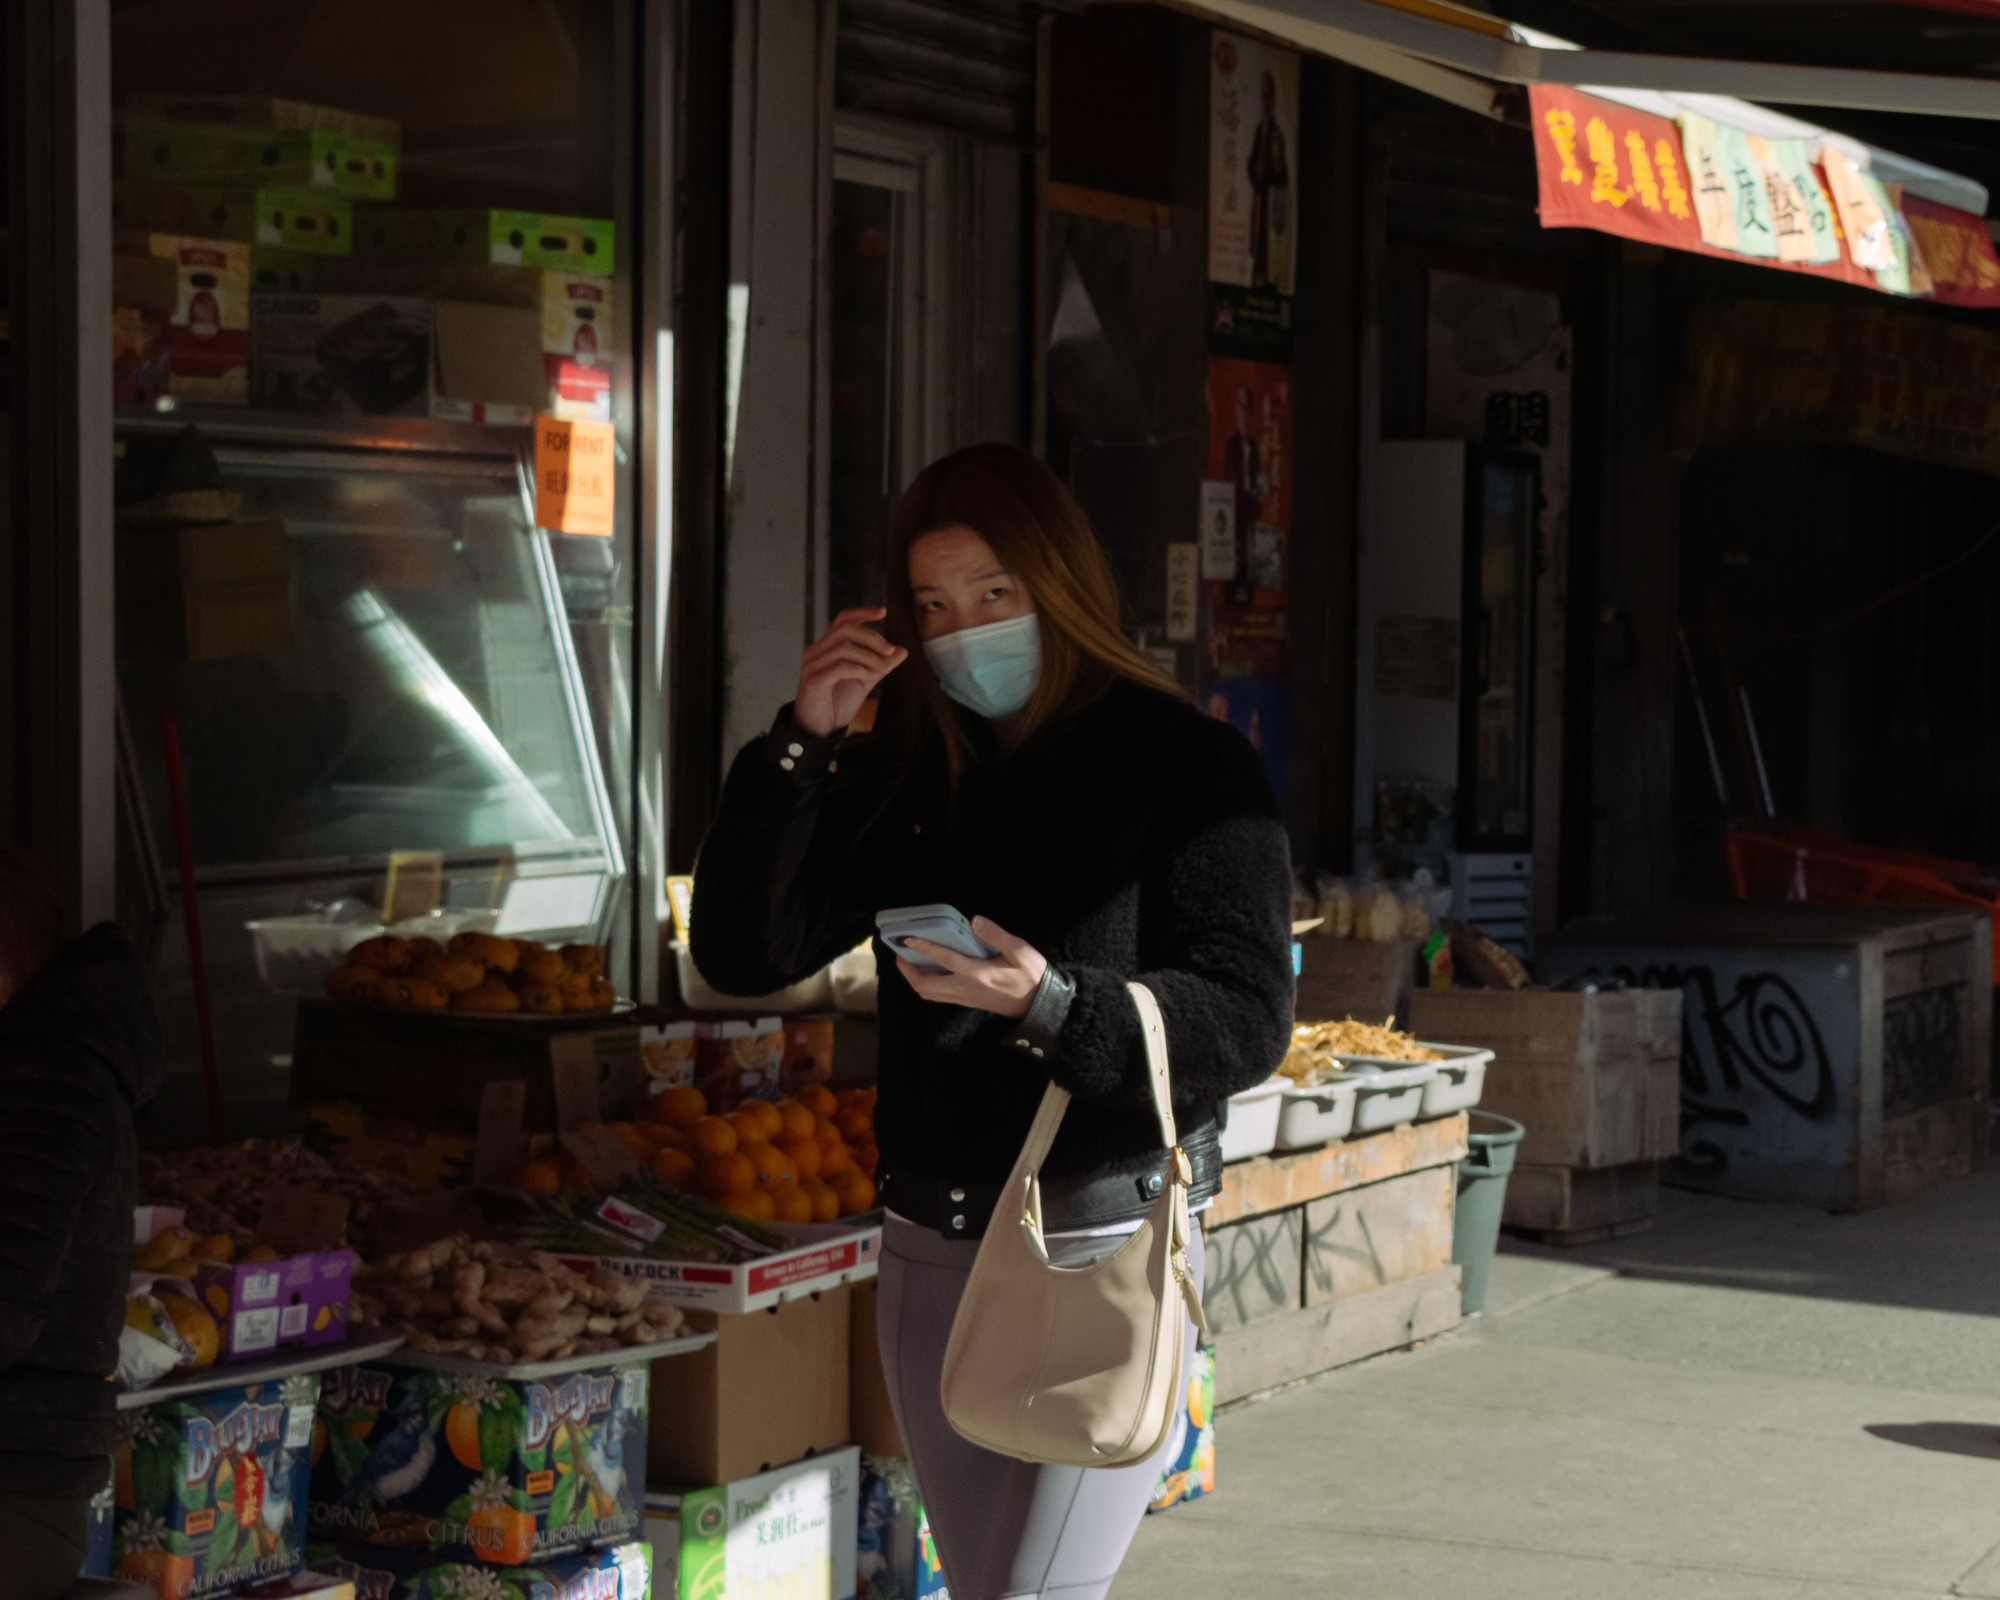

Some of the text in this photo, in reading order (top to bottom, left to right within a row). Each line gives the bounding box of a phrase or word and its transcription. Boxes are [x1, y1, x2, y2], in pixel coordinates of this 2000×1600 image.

[256, 296, 320, 316] CASIO
[574, 436, 606, 456] RENT
[425, 1519, 506, 1552] CITRUS
[521, 1509, 640, 1552] CALIFORNIA CITRUS
[177, 1563, 257, 1597] CALIFORNIA
[257, 1546, 302, 1575] CITRUS
